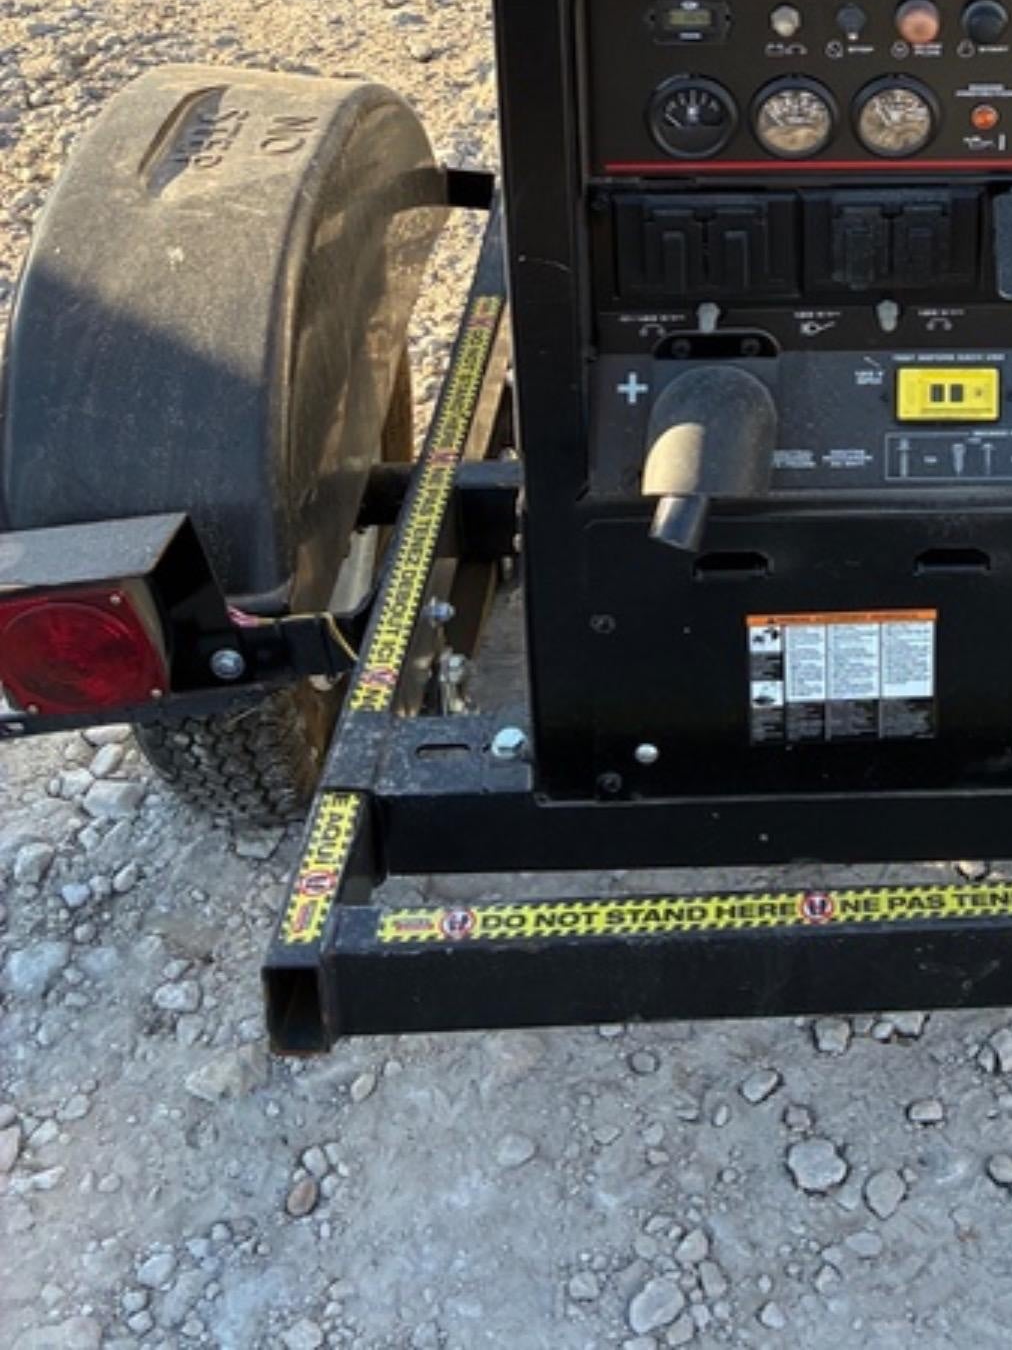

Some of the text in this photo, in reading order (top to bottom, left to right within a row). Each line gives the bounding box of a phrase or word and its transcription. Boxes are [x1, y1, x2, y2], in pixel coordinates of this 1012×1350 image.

[839, 897, 881, 912] NE
[888, 895, 945, 910] PAS
[481, 902, 796, 929] DO NOT STAND HERE
